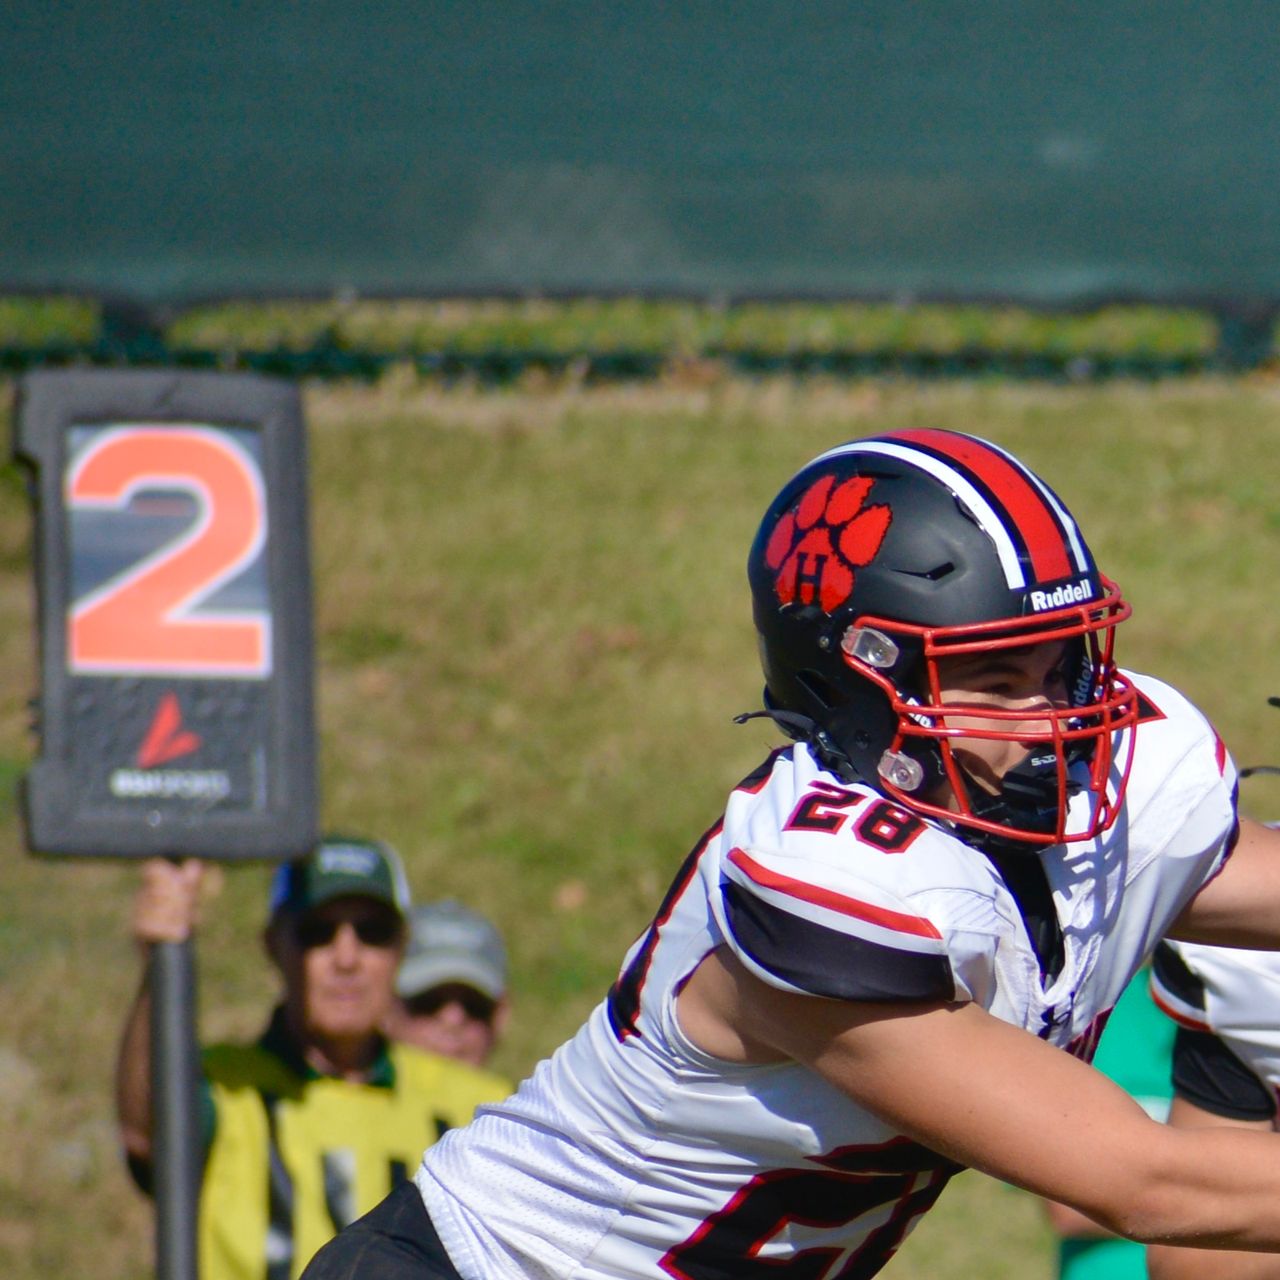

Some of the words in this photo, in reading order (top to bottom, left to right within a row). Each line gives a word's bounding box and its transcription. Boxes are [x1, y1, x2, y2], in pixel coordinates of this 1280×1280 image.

[66, 426, 269, 678] 2
[1030, 578, 1093, 611] Riddell
[782, 779, 930, 855] 28
